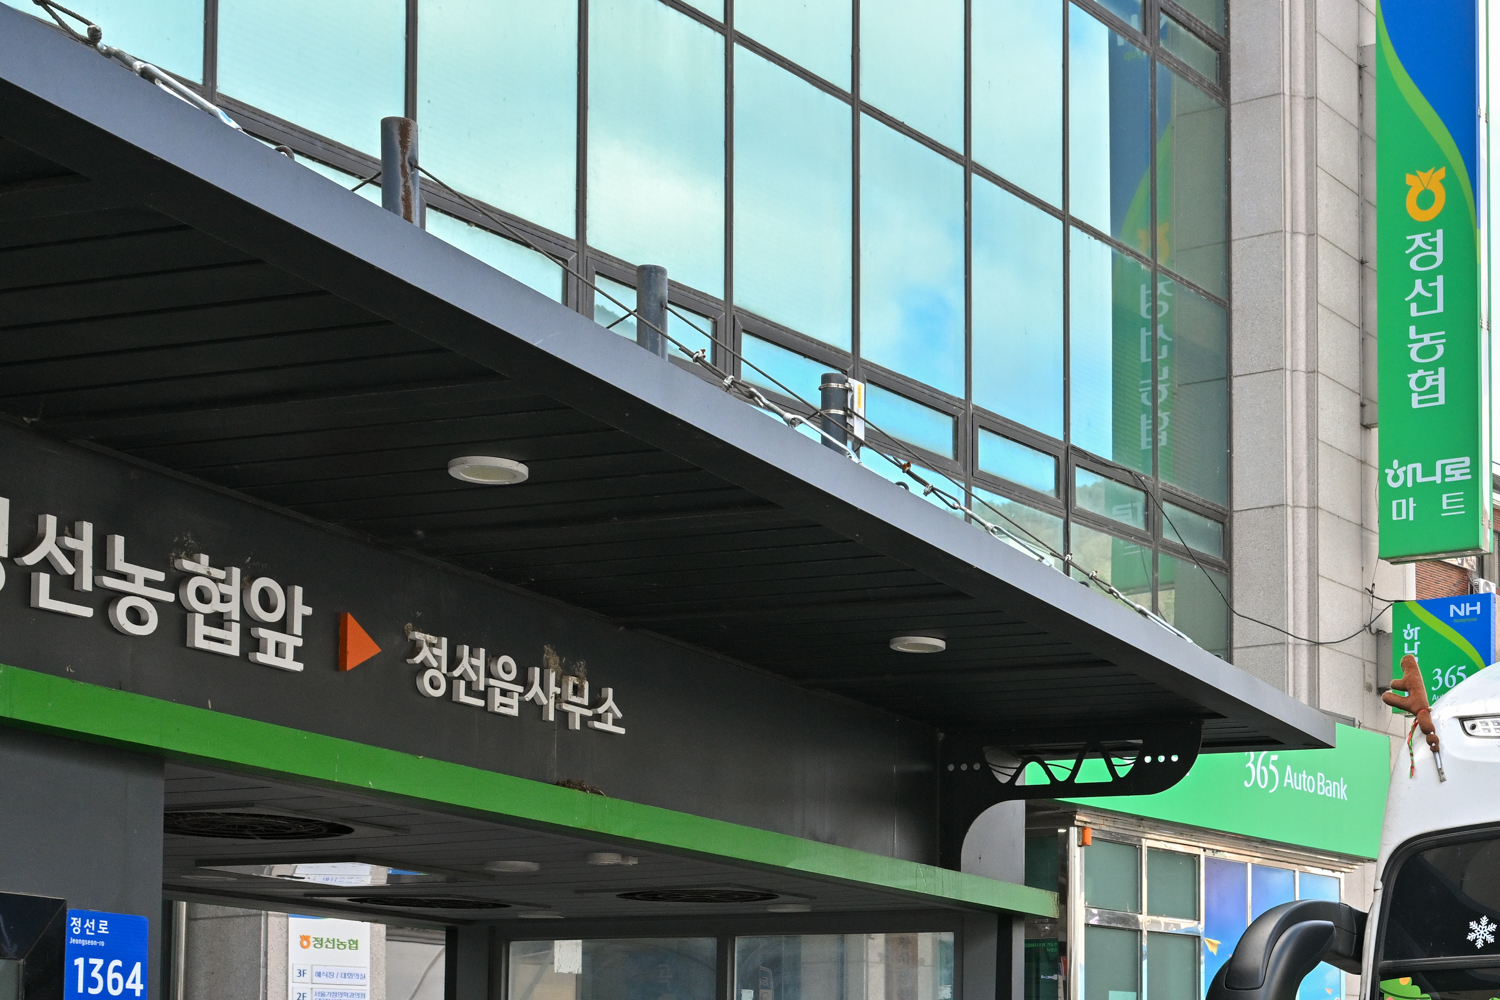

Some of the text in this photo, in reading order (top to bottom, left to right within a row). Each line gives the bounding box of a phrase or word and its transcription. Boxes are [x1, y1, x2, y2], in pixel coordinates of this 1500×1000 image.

[1404, 228, 1446, 409] 정선농협
[1384, 456, 1472, 489] 하나로
[0, 496, 312, 672] 선농협앞
[1449, 602, 1481, 617] NH
[406, 631, 626, 734] 정선읍사무소
[1244, 751, 1348, 801] 365 Auto Bank
[70, 917, 110, 935] 정선로
[69, 937, 105, 947] Jeongseon-ro
[312, 936, 359, 951] 정선농협
[73, 957, 144, 997] 1364
[296, 969, 307, 978] 3F
[296, 992, 307, 1000] 2F
